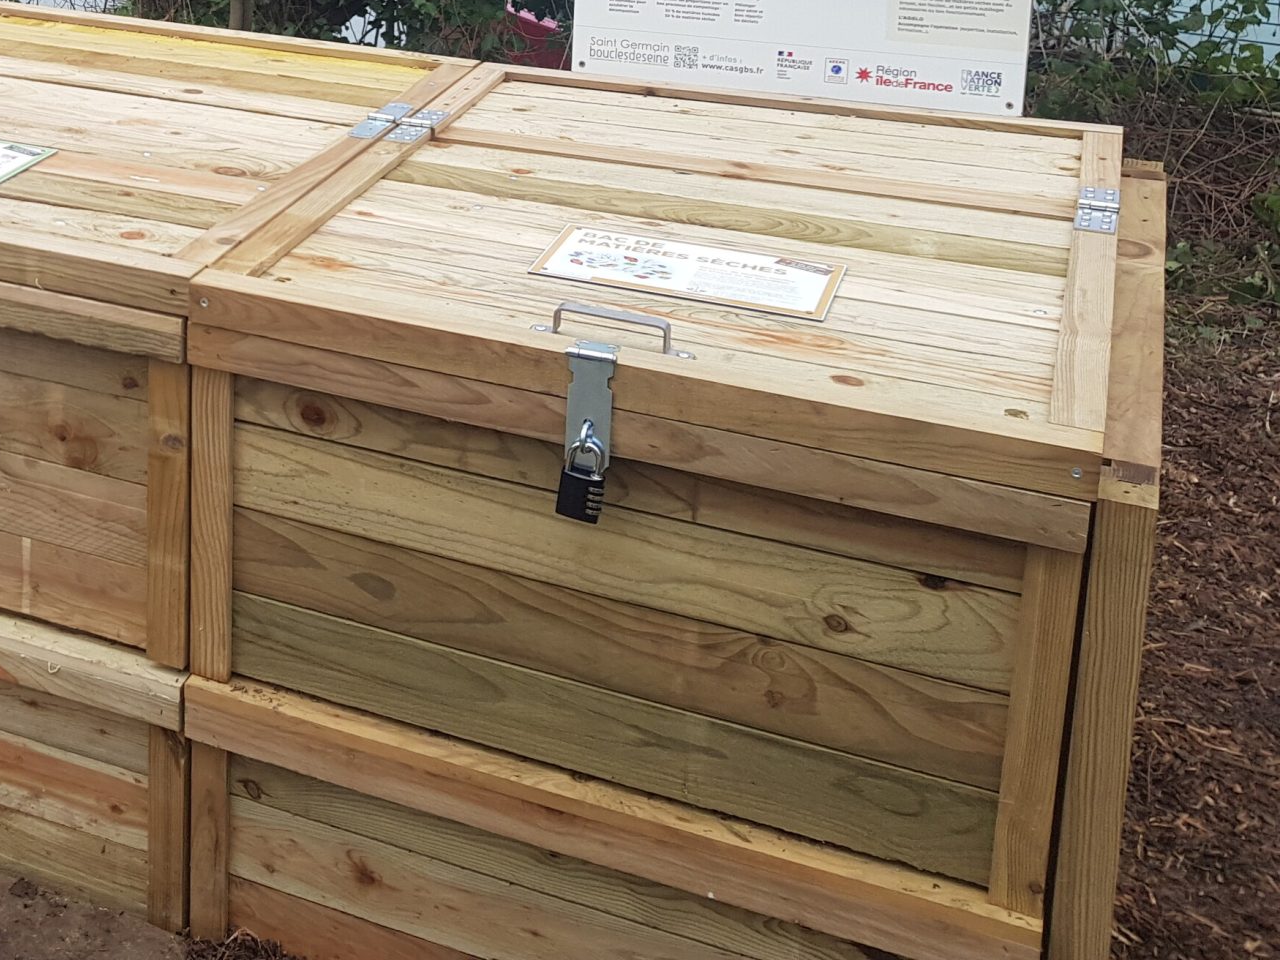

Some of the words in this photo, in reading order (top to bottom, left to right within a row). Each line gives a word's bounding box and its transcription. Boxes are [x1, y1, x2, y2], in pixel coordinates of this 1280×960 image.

[590, 37, 617, 48] Saint
[620, 39, 670, 53] Germain
[590, 46, 669, 65] bouclesdeseine
[709, 54, 737, 63] d'infos
[702, 62, 764, 75] www.casgbs.fr
[876, 65, 917, 80] Région
[581, 232, 629, 244] BAC
[635, 239, 667, 249] DE
[577, 238, 690, 260] MATIÈRES
[695, 254, 788, 276] SÈCHES
